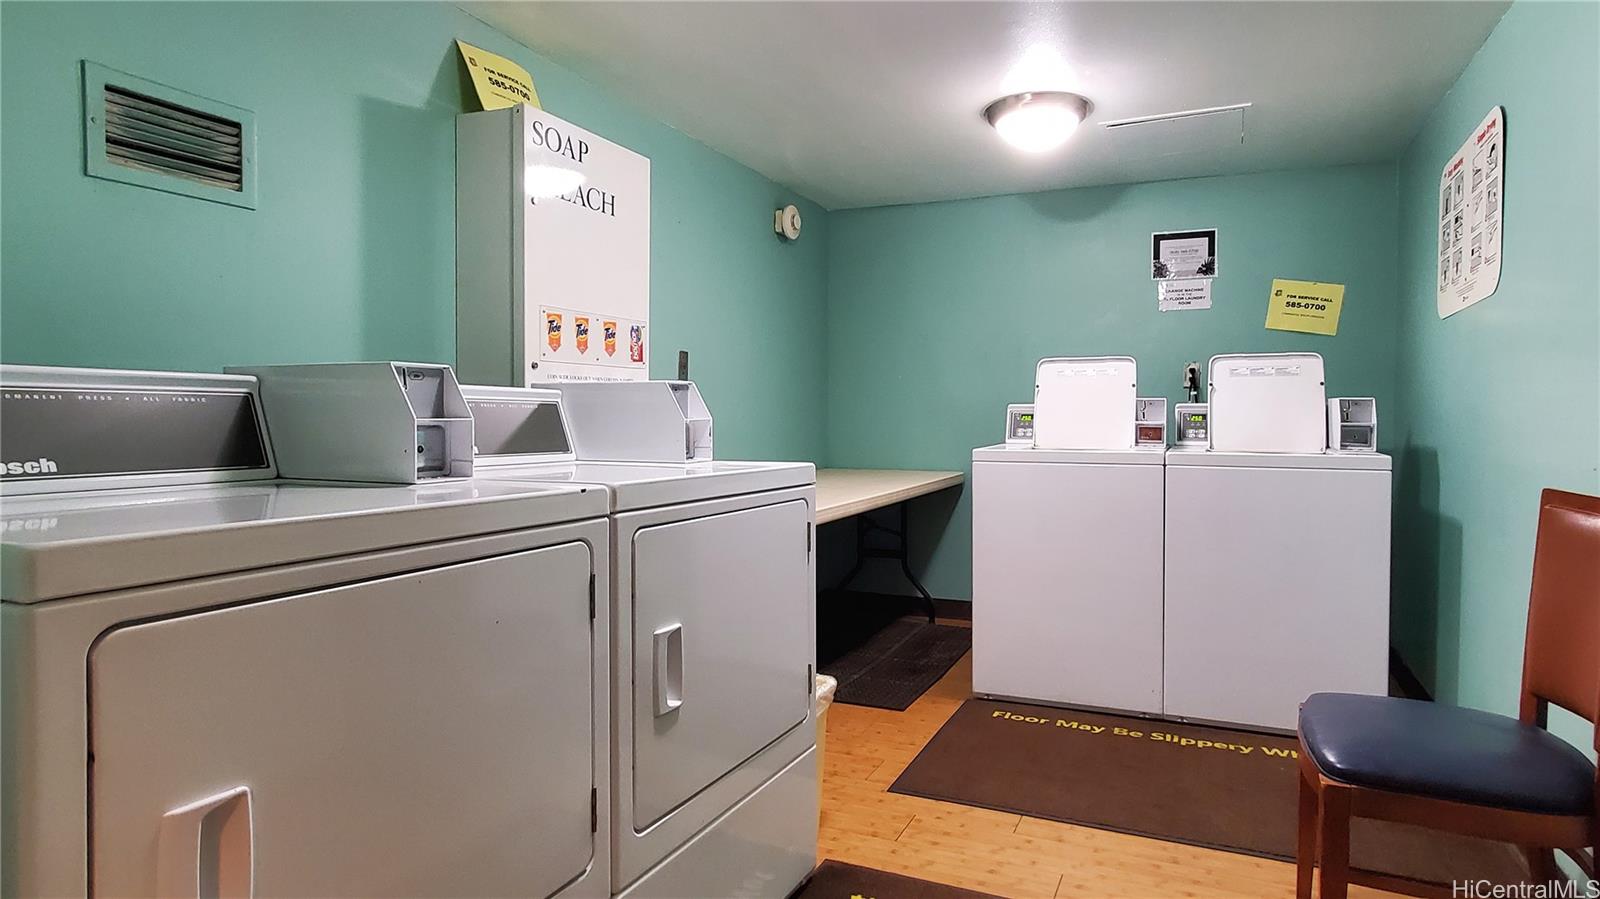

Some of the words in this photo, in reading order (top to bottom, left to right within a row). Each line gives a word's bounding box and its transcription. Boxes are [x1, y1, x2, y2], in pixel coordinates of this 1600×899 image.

[487, 76, 531, 101] 585-0700
[532, 120, 589, 163] SOAP
[1285, 301, 1326, 311] 585-0700
[548, 319, 562, 335] Tide
[575, 323, 589, 338] Tide
[604, 327, 616, 341] Tide
[992, 710, 1050, 724] Floor
[1055, 718, 1106, 734] May
[1112, 726, 1144, 738] Be
[1149, 731, 1254, 754] Slippery
